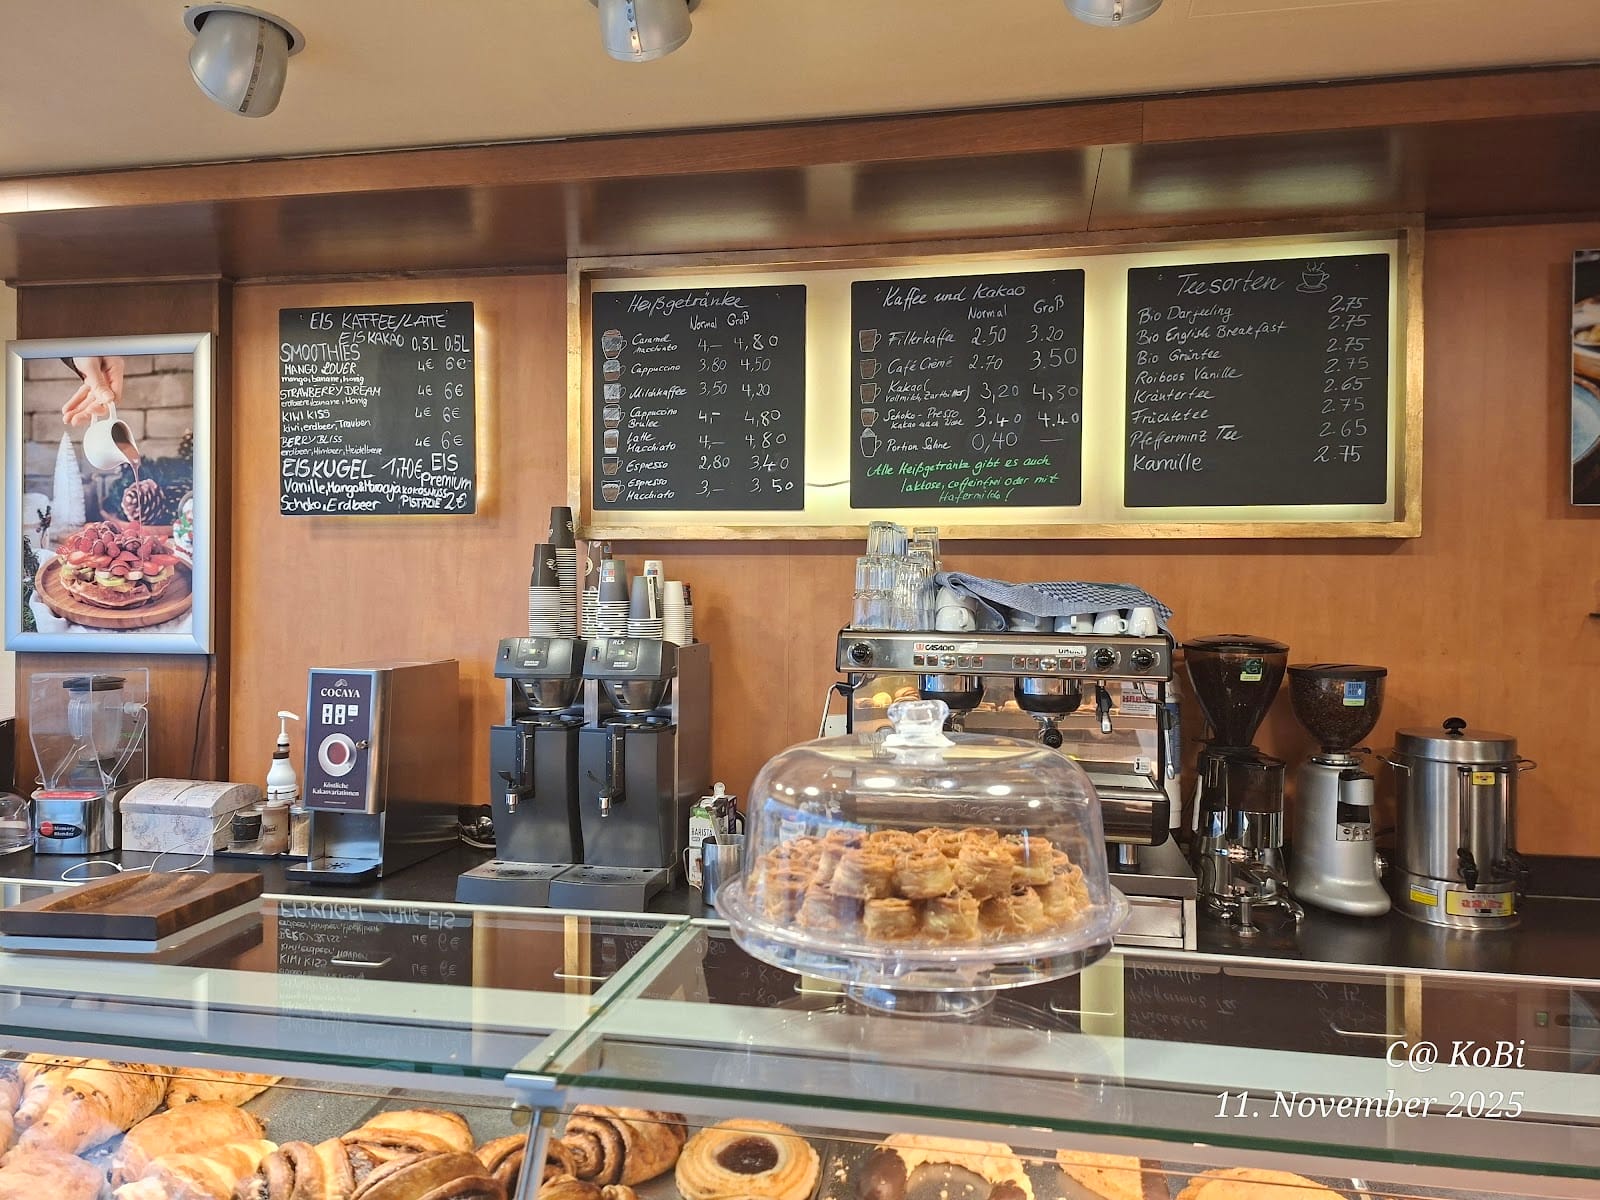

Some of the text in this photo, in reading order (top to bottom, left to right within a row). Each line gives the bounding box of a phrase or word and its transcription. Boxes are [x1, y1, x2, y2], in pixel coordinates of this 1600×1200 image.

[1177, 270, 1288, 296] Teesorten
[628, 291, 749, 317] Heißgetränke
[883, 284, 1026, 310] Kaffee und Kakao
[968, 295, 1064, 320] Normal Groß
[1138, 308, 1161, 324] Bio
[1328, 295, 1369, 313] 2.75
[310, 312, 333, 330] EIS
[690, 311, 750, 330] Normal Groß
[1136, 314, 1372, 345] Bio English Breakfast 2.75
[412, 335, 470, 352] 0,3L 0,5L
[734, 334, 779, 352] 4,80
[972, 325, 1006, 346] 2.50
[1026, 324, 1064, 343] 3.20
[280, 342, 360, 362] SMOOTHIES
[969, 354, 1002, 370] 2.70
[1030, 348, 1077, 370] 3.50
[1137, 351, 1158, 365] Bio
[1326, 337, 1371, 352] 2.75
[284, 363, 318, 375] MANGO
[418, 358, 434, 372] 4€
[631, 357, 771, 376] Cappuccino 3,80 4,50
[1194, 366, 1244, 381] Vanille
[1324, 358, 1369, 375] 2.75
[280, 382, 464, 400] STRAWBERRY DREAM 4€ 6€
[700, 381, 728, 396] 3,50
[742, 383, 771, 399] 4,20
[980, 383, 1018, 404] 3,20
[1323, 376, 1372, 393] 2.65
[282, 406, 461, 422] KIWI KISS 4€ 6€
[1321, 398, 1365, 414] 2.75
[630, 406, 678, 418] Cappuccino
[744, 410, 781, 427] 4,80
[976, 407, 1022, 427] 3.40
[1038, 412, 1079, 427] 4.40
[416, 436, 431, 446] 4€
[442, 430, 464, 449] 6€
[745, 432, 786, 449] 4,80
[1216, 424, 1242, 441] Tee
[887, 438, 918, 452] Portion
[972, 432, 1018, 453] 0,40
[282, 452, 458, 480] EISKUGEL 1,70€ EIS
[626, 454, 789, 473] Espresso 2,80 3,40
[972, 458, 1001, 475] gibt
[1004, 458, 1019, 468] es
[1023, 455, 1051, 466] auch
[1132, 446, 1364, 472] Kamille 2.75
[627, 478, 667, 488] Espresso
[1005, 476, 1027, 486] oder
[1034, 473, 1059, 484] mit
[444, 492, 466, 510] 2€
[320, 688, 360, 698] COCAYA
